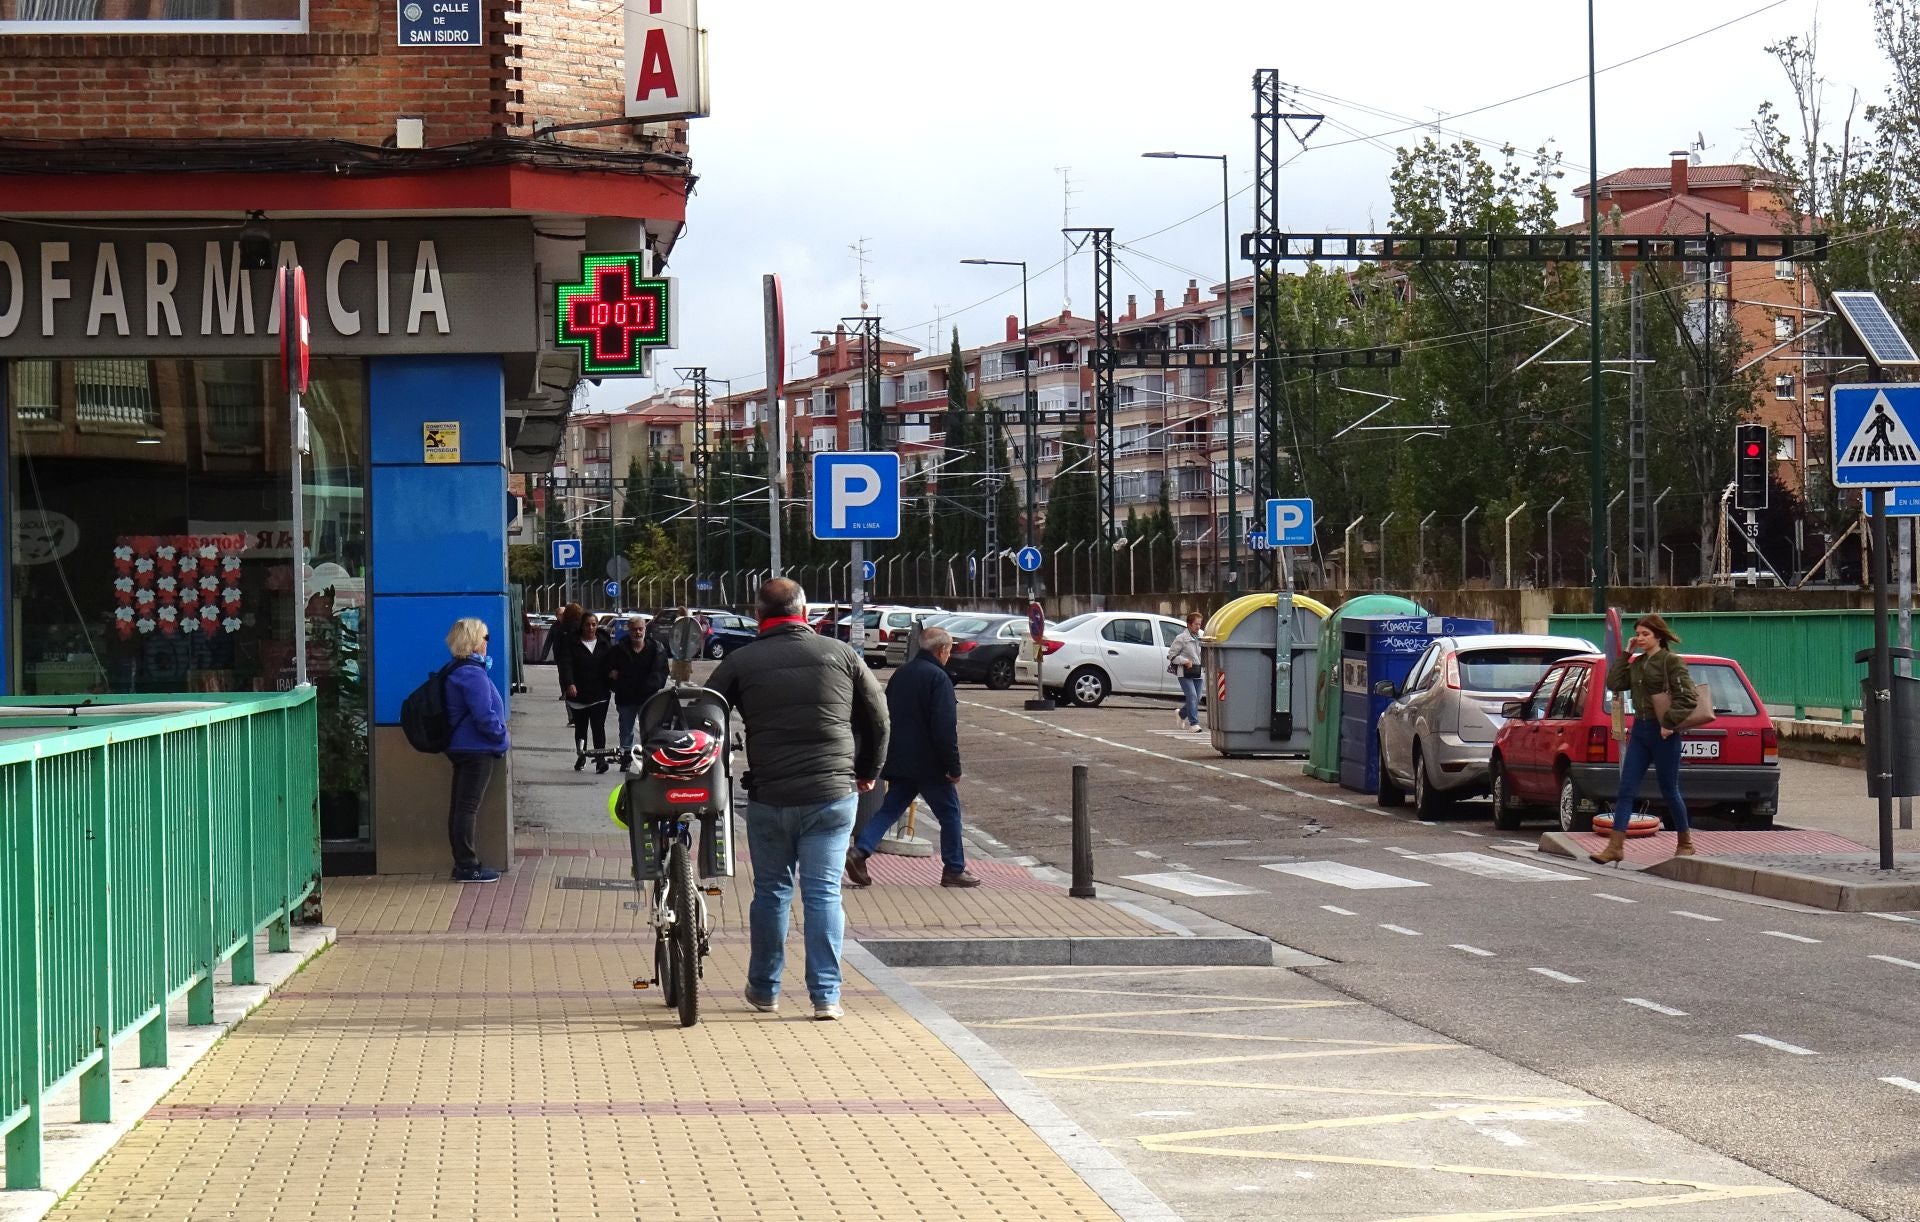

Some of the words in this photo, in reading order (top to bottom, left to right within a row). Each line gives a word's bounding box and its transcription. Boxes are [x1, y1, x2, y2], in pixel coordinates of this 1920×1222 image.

[433, 3, 469, 13] CALLE
[433, 17, 446, 25] DE
[410, 31, 431, 42] SAN
[435, 30, 469, 42] ISIDRO
[831, 463, 882, 529] P
[1276, 505, 1304, 541] P
[1747, 525, 1759, 537] S5
[558, 544, 576, 566] P
